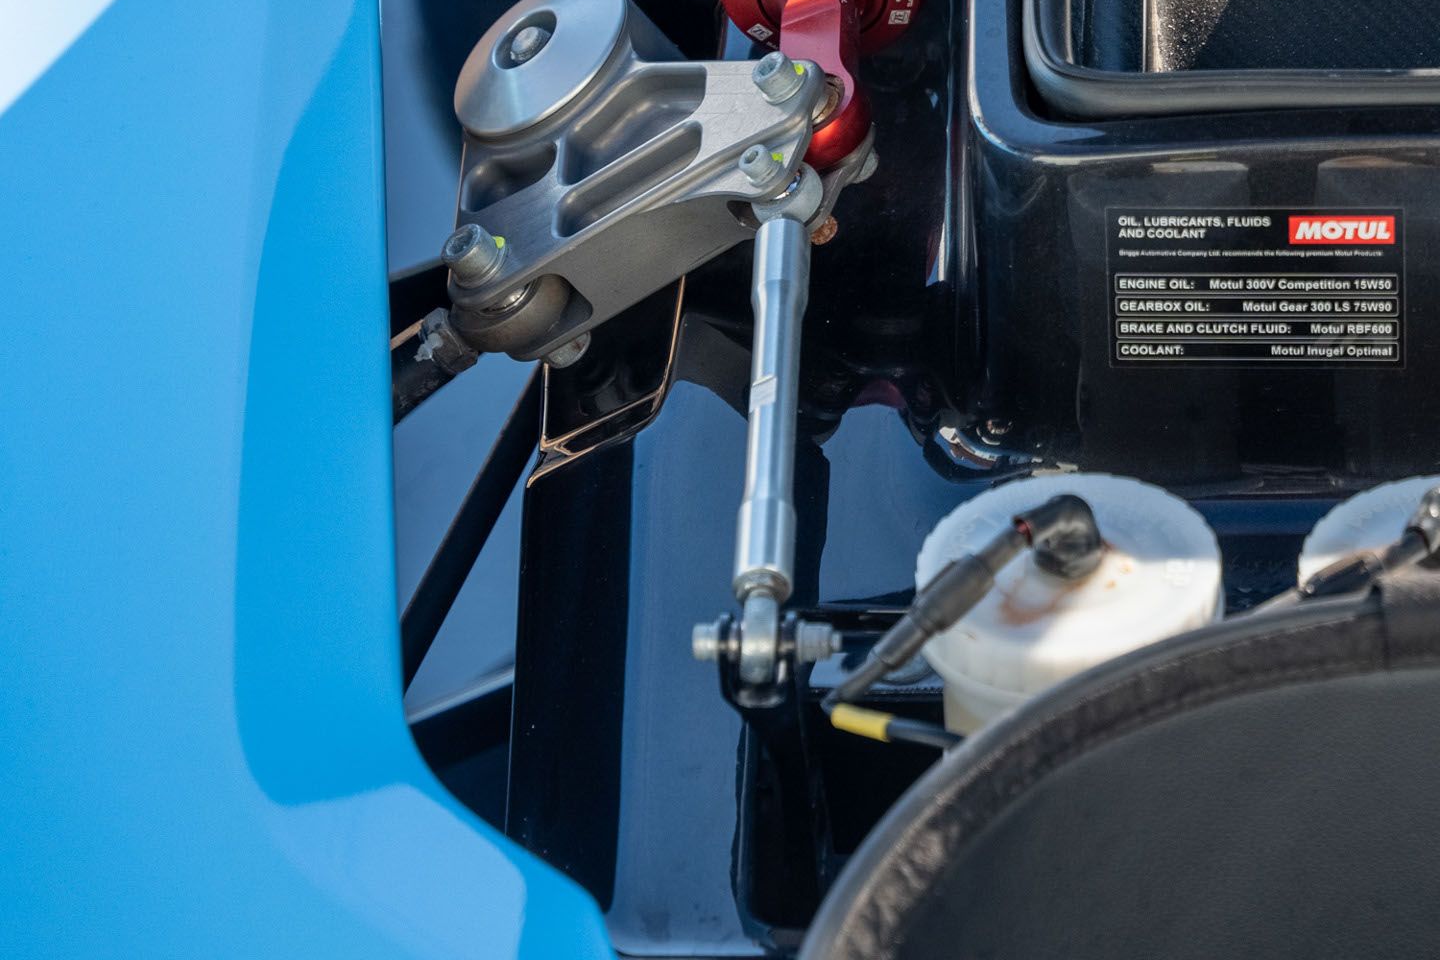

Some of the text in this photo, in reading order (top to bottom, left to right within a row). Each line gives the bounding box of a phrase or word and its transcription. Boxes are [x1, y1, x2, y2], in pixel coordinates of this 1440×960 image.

[1144, 216, 1225, 229] LUBRICANTS,
[1227, 216, 1271, 227] FLUIDS
[1118, 227, 1206, 239] AND COOLANT
[1294, 221, 1391, 240] MOTUL
[1177, 249, 1207, 257] Company
[1222, 249, 1263, 257] recommends
[1275, 249, 1305, 257] following
[1306, 249, 1334, 257] premium
[1119, 278, 1195, 289] ENGINE OIL:
[1209, 279, 1392, 291] Motul 300V Competition 15W50
[1119, 301, 1210, 312] GEARBOX OIL:
[1242, 301, 1392, 312] Motul Gear 300 LS 75W90
[1120, 323, 1292, 334] BRAKE AND CLUTCH FLUID:
[1310, 323, 1392, 334] Motul RBF600
[1121, 344, 1184, 355] COOLANT:
[1271, 345, 1393, 357] Motul Inugel Optimal
